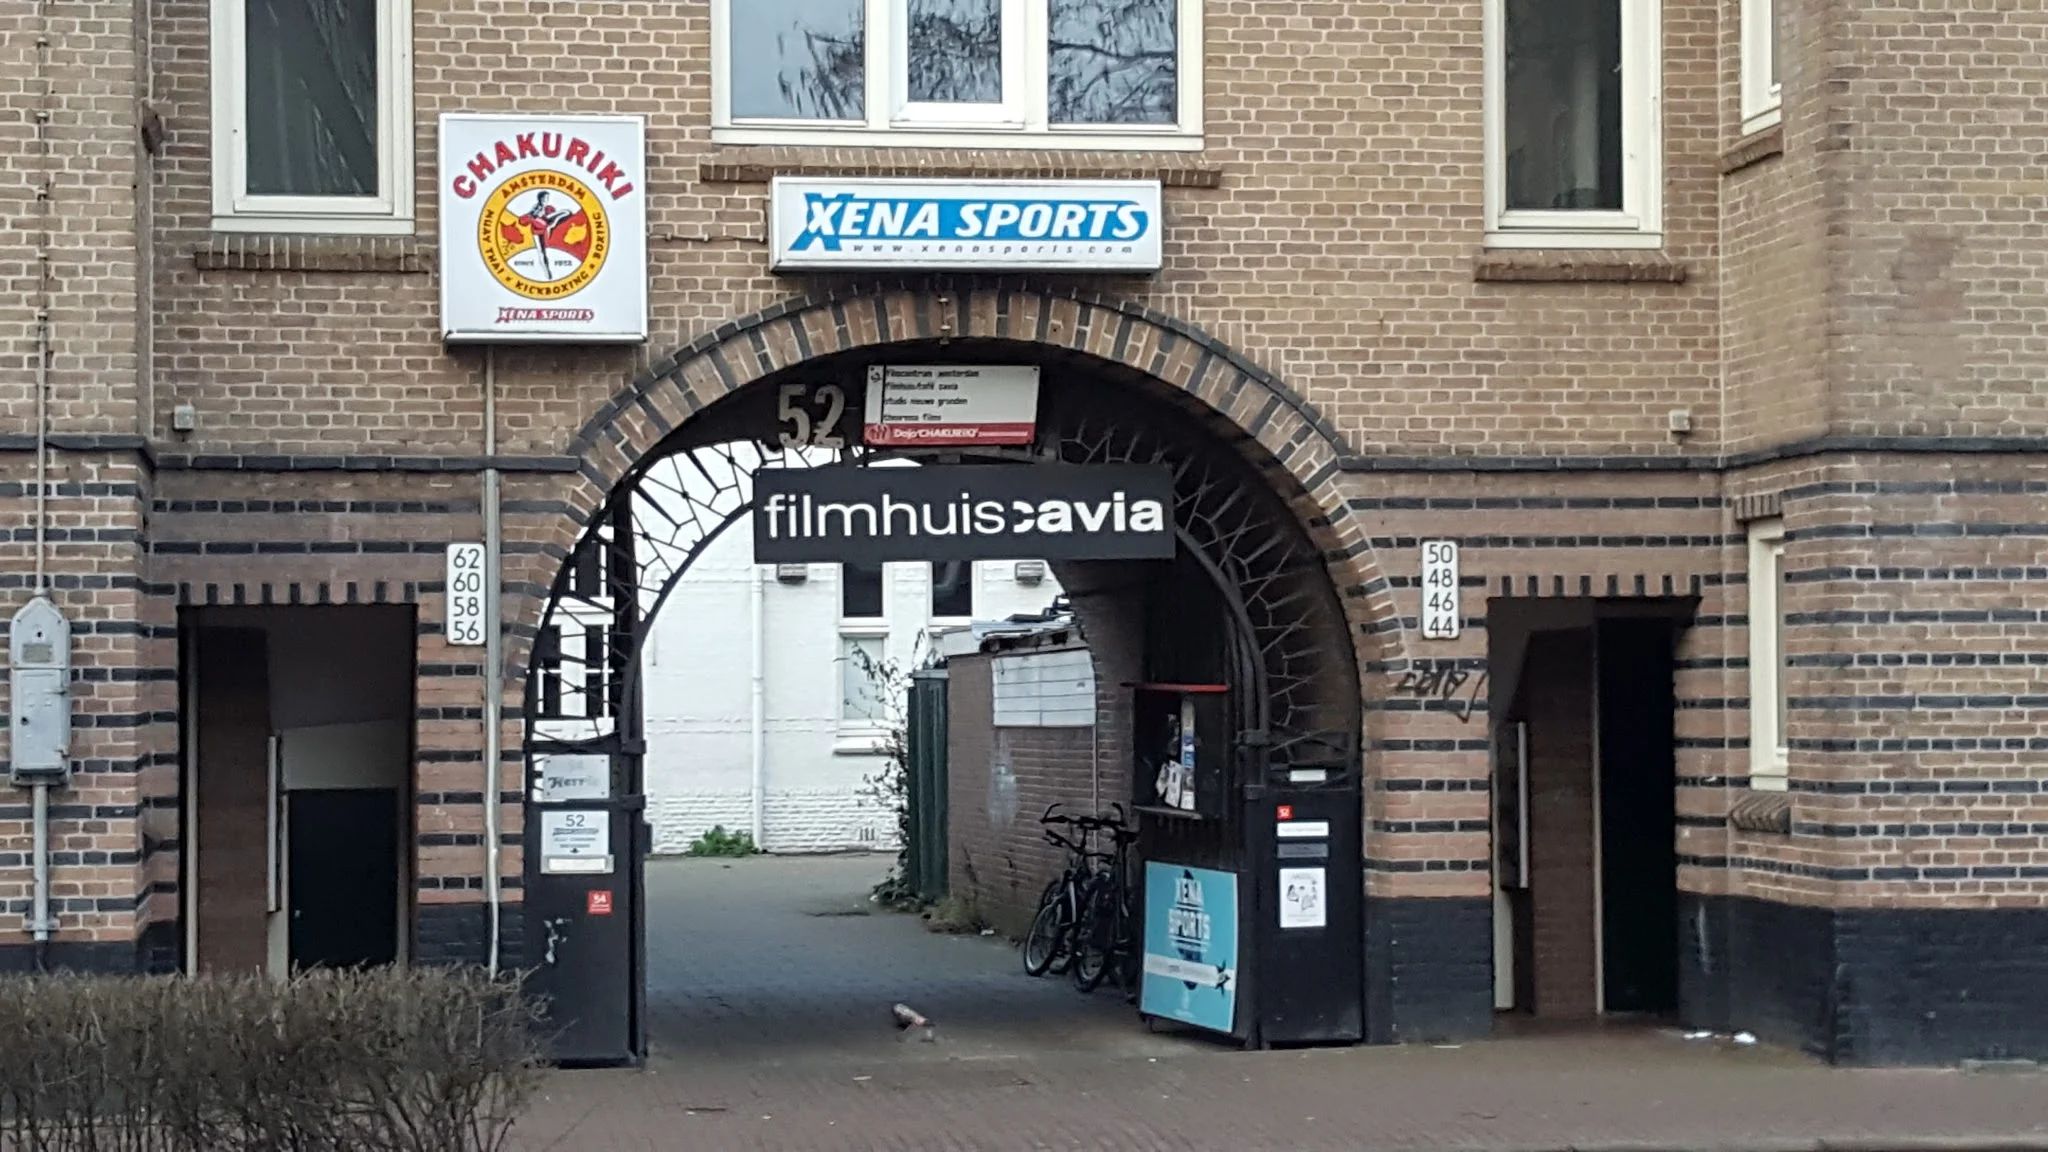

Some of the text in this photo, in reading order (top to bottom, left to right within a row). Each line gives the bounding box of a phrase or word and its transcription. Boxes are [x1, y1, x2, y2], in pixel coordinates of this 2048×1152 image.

[453, 131, 634, 200] CHAKURIKI
[501, 174, 586, 200] AMSTERDAM
[797, 195, 1141, 244] XENA SPORTS
[482, 209, 505, 274] MUAY THAI
[592, 212, 605, 260] BOXING
[853, 242, 1133, 255] www.xenasports.com
[514, 271, 589, 296] KICKBOXING
[498, 307, 592, 321] XENA SPORTS
[778, 383, 845, 450] 52
[453, 547, 480, 569] 62
[1427, 543, 1454, 565] 50
[453, 572, 480, 593] 60
[1427, 568, 1454, 588] 48
[453, 596, 480, 617] 58
[1428, 592, 1455, 612] 46
[453, 620, 480, 641] 56
[1428, 615, 1455, 636] 44
[565, 813, 585, 828] 52
